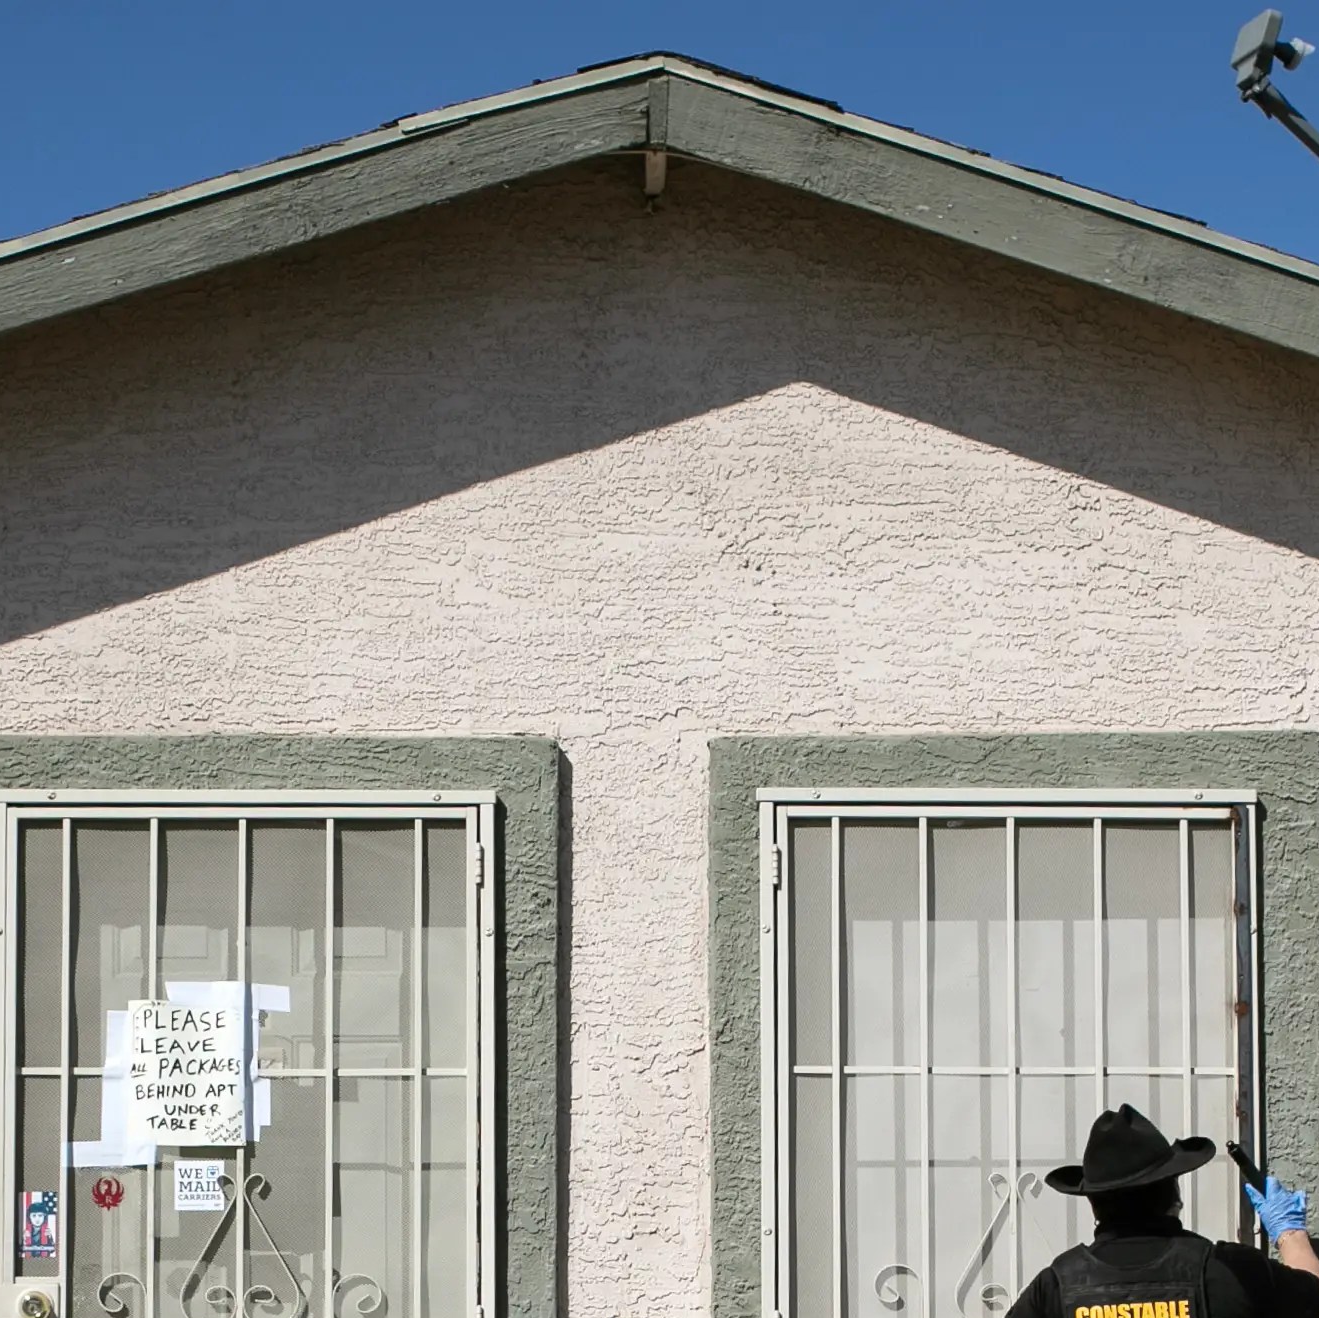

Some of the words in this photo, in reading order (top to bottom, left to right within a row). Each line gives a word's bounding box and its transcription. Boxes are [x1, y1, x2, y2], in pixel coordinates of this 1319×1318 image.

[143, 1008, 226, 1032] PLEASE
[140, 1037, 216, 1055] LEAVE
[130, 1063, 147, 1076] ALL
[159, 1058, 241, 1079] PACKAGES
[135, 1083, 196, 1100] BEHIND
[205, 1083, 238, 1098] APT
[164, 1103, 221, 1117] UNDER
[146, 1115, 198, 1131] TABLE
[178, 1168, 203, 1180] WE
[178, 1180, 221, 1192] MAIL
[178, 1193, 222, 1201] CARRIERS
